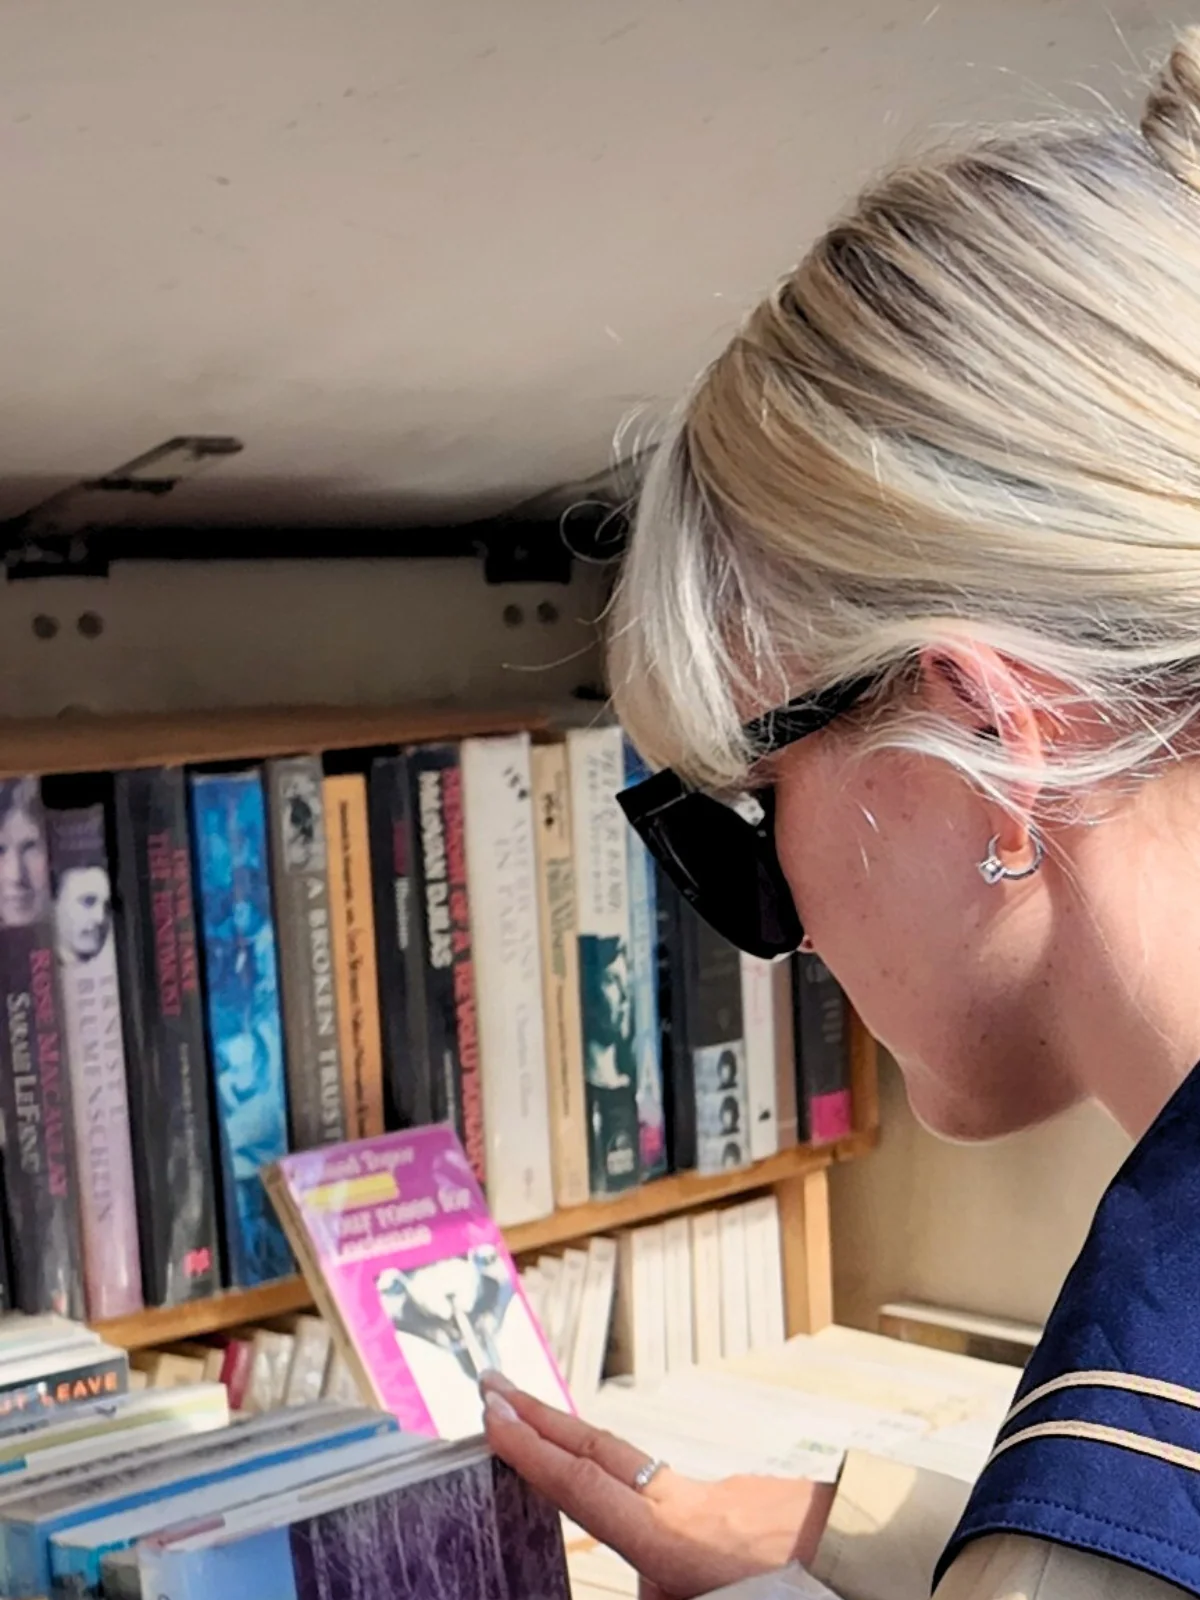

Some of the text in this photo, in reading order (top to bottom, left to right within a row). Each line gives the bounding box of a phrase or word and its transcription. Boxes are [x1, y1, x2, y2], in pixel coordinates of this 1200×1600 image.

[305, 878, 325, 900] A
[308, 908, 336, 1037] BROKEN
[37, 1371, 118, 1408] LEAVE
